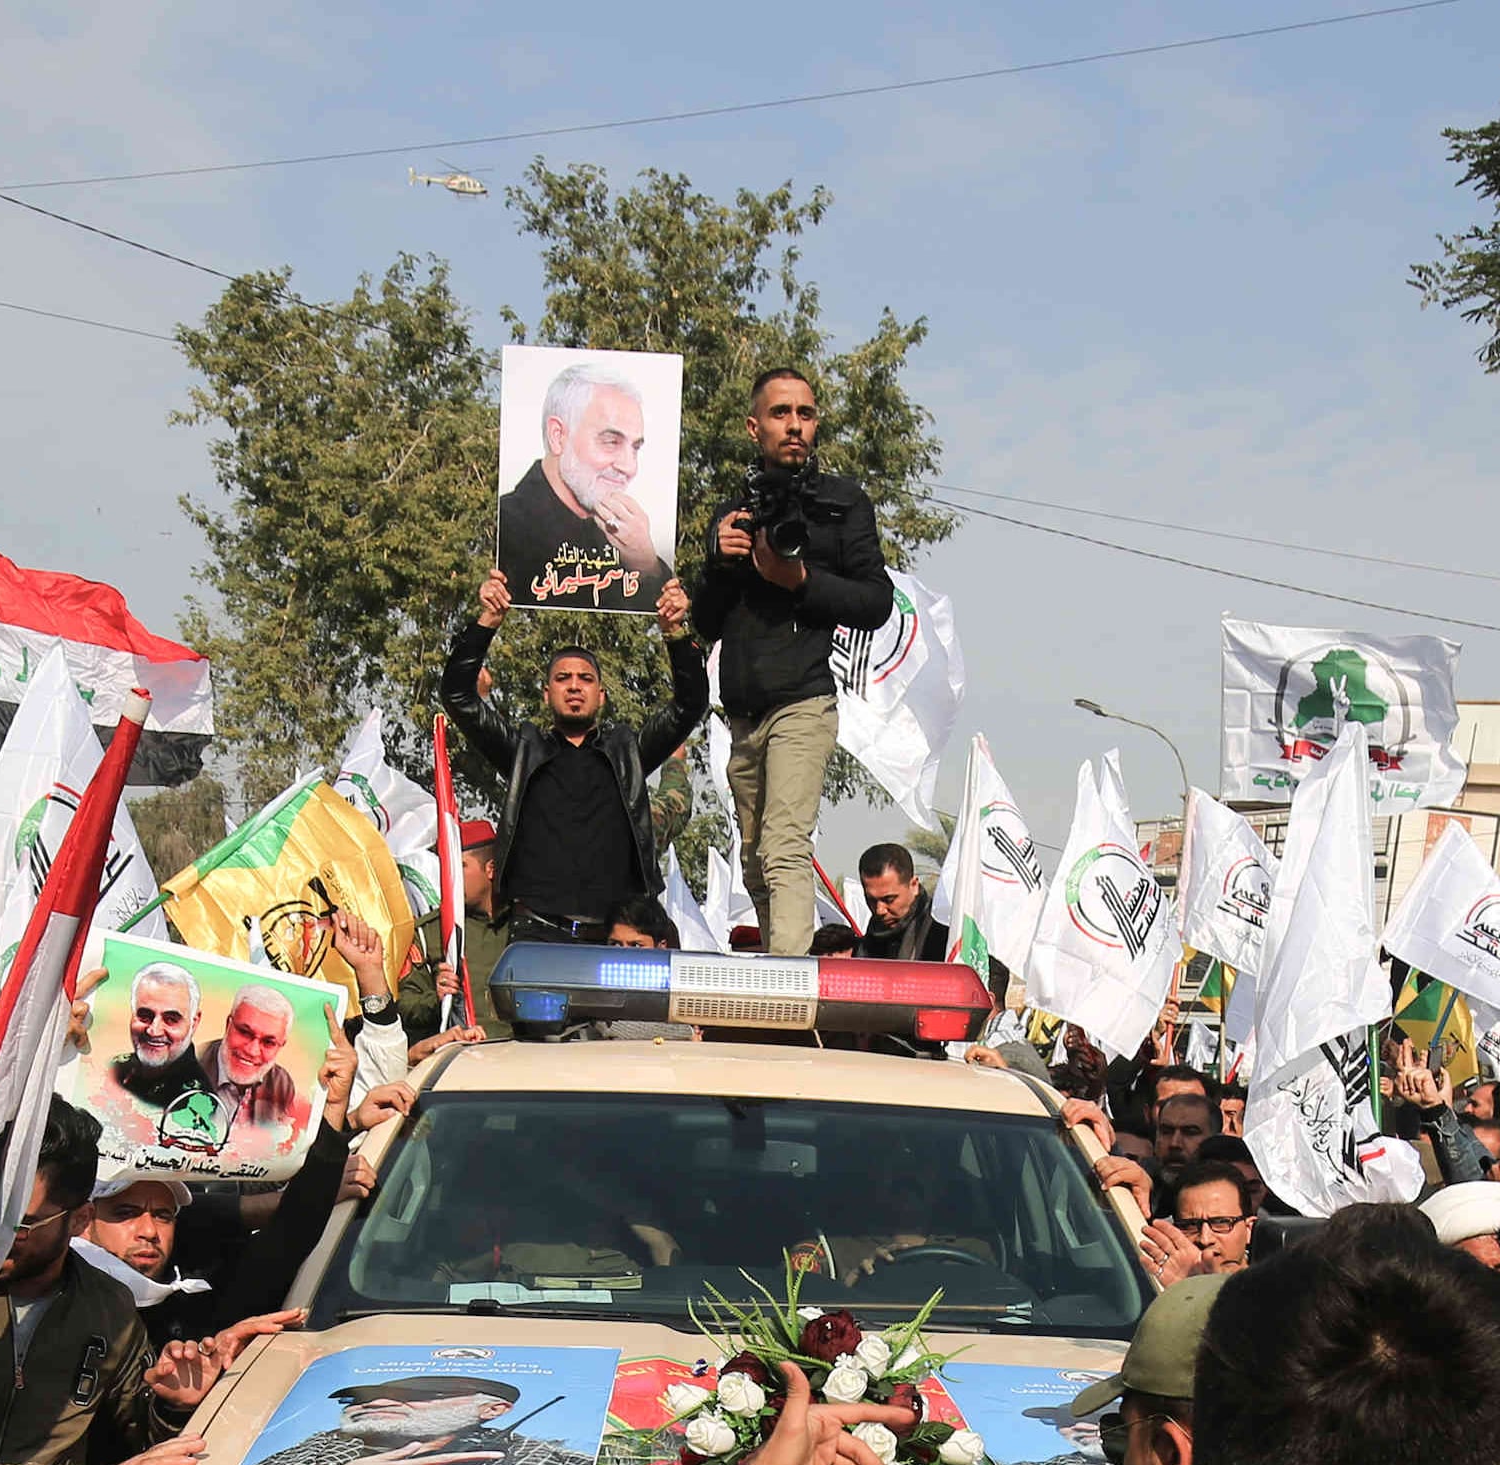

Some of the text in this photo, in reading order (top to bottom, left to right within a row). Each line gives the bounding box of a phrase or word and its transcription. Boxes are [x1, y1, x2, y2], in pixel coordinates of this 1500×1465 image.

[579, 543, 620, 570] الشهيد
[530, 561, 640, 607] قاسم سليماني
[134, 1148, 192, 1171] الحسين
